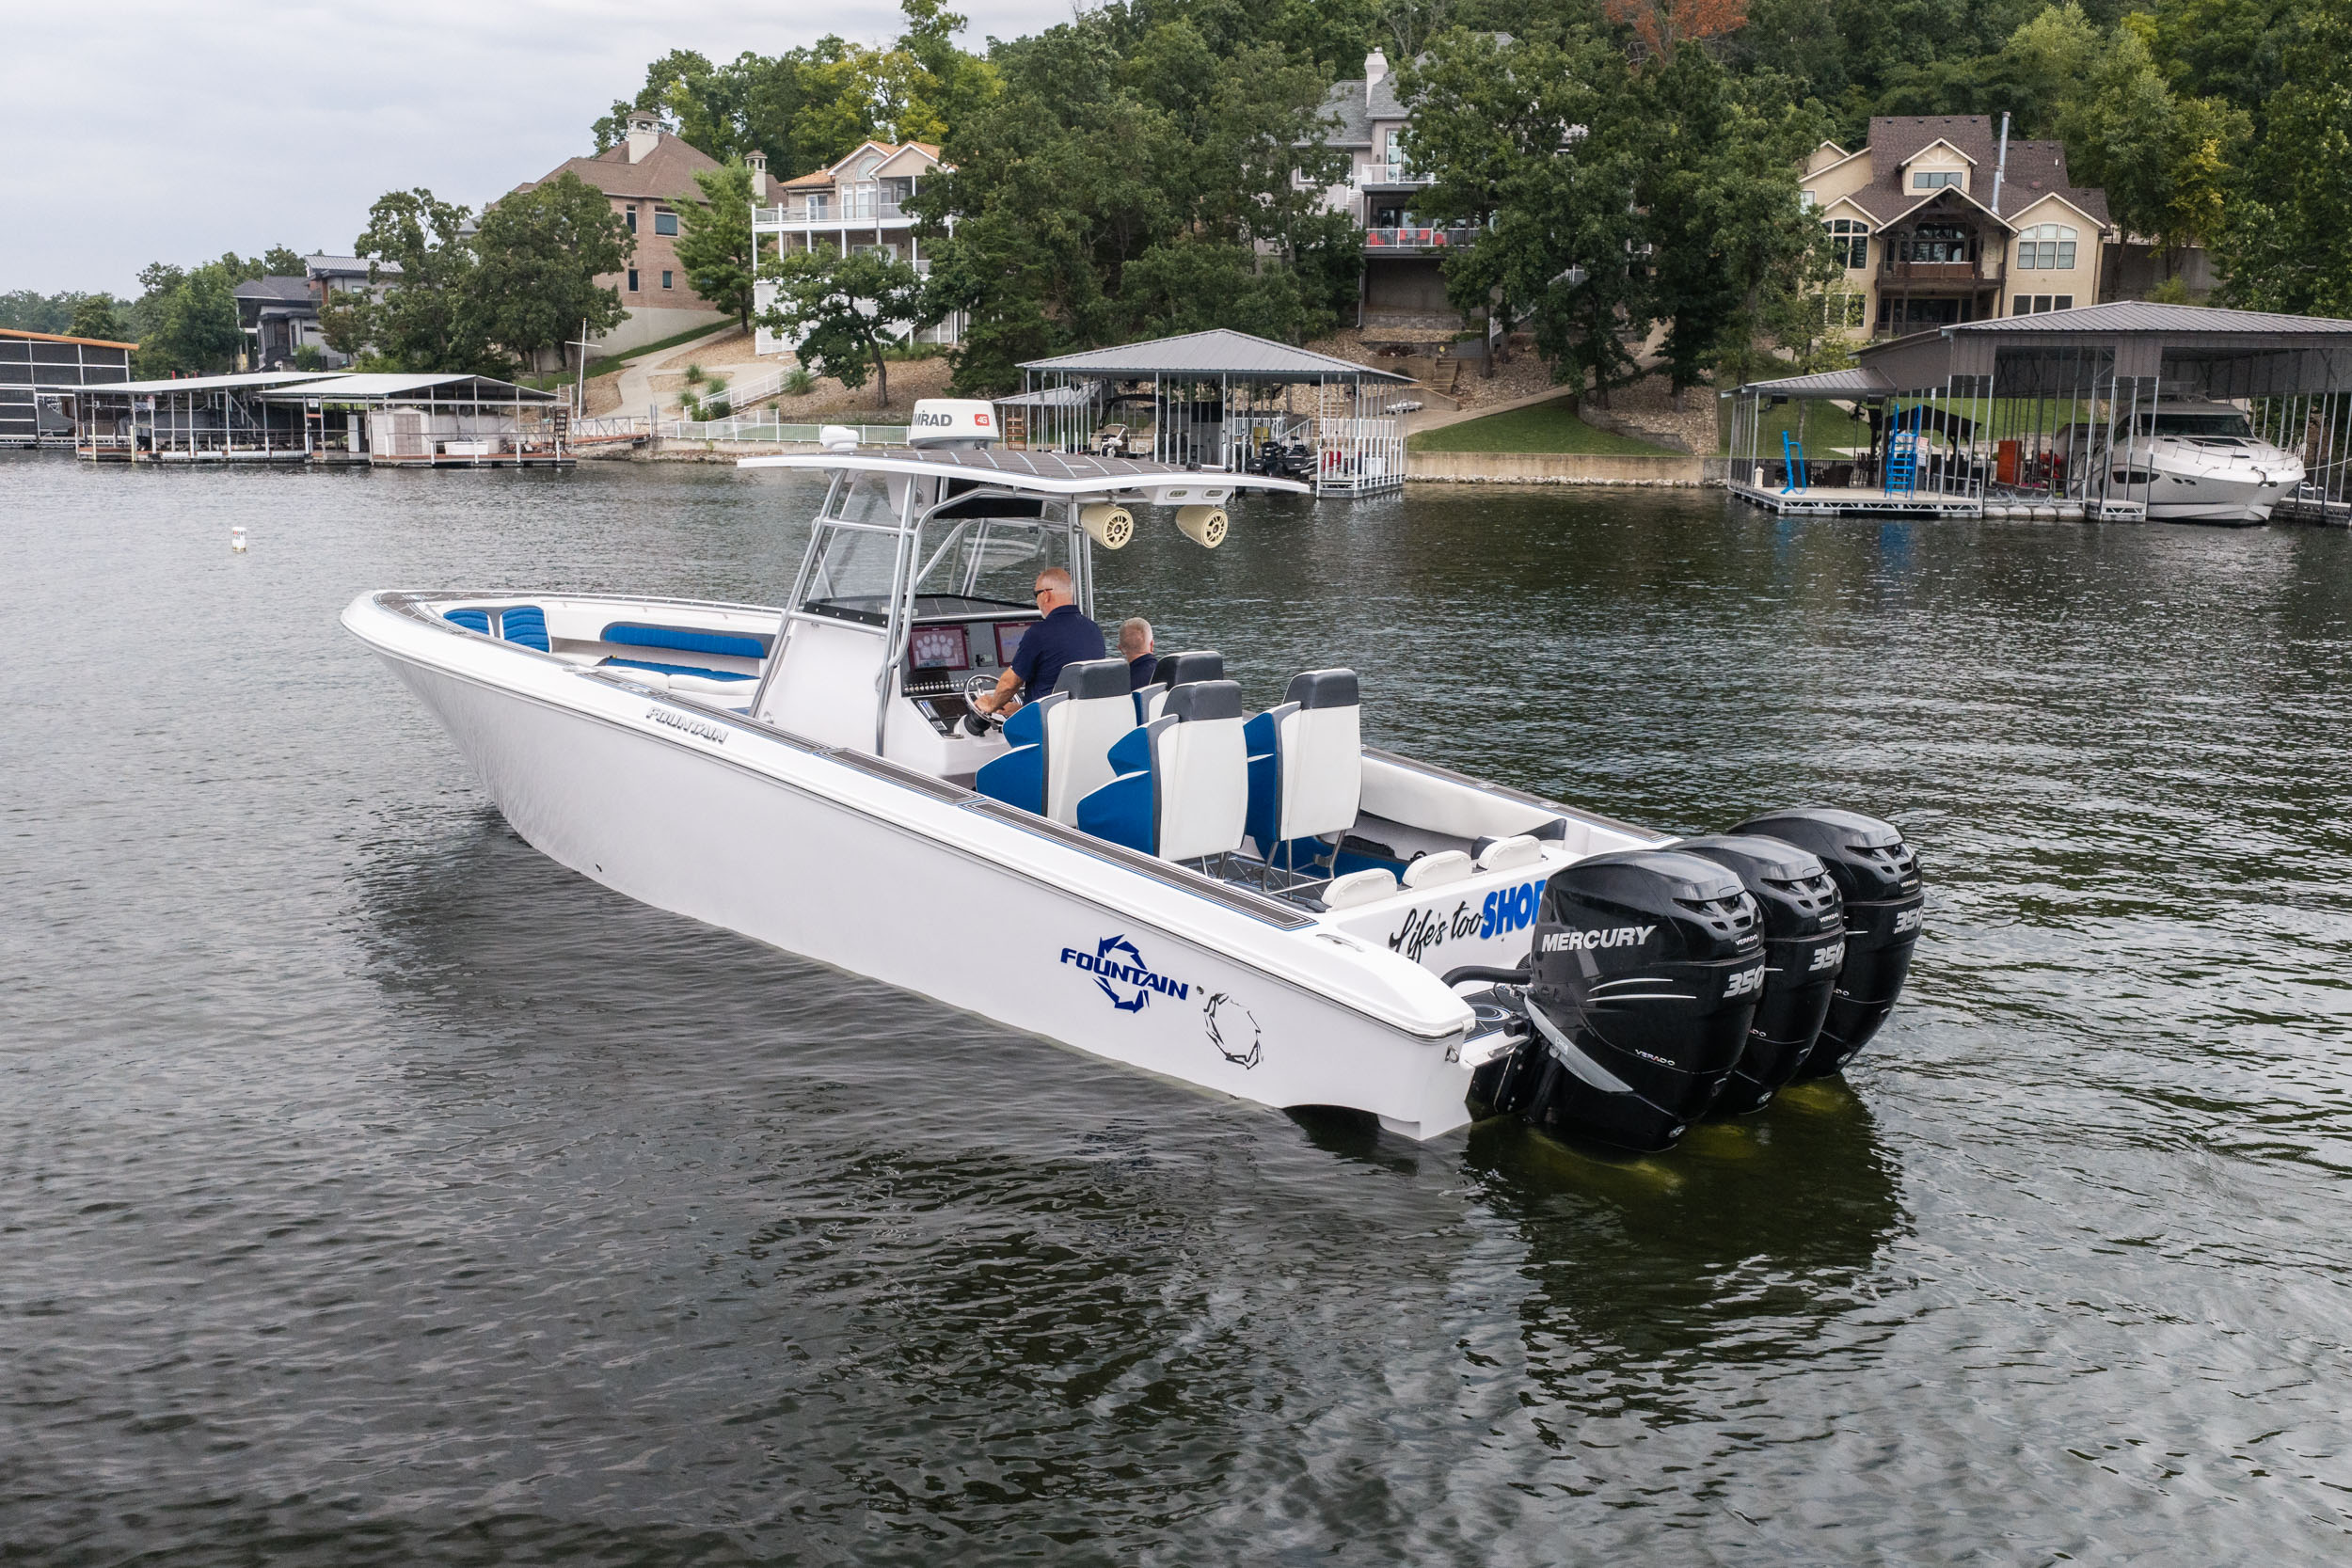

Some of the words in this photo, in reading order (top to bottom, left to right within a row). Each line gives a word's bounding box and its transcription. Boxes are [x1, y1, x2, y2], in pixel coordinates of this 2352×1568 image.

[977, 415, 988, 425] 4G
[645, 706, 729, 745] FOUNTAIN
[1389, 908, 1448, 964] Life's
[1451, 900, 1485, 941] too
[1541, 925, 1658, 953] MERCURY
[1735, 933, 1758, 946] VERADO
[1808, 941, 1846, 972] 350
[1060, 947, 1189, 1001] FOUNTAIN
[1723, 964, 1765, 999] 350
[1634, 1048, 1676, 1067] VERADO
